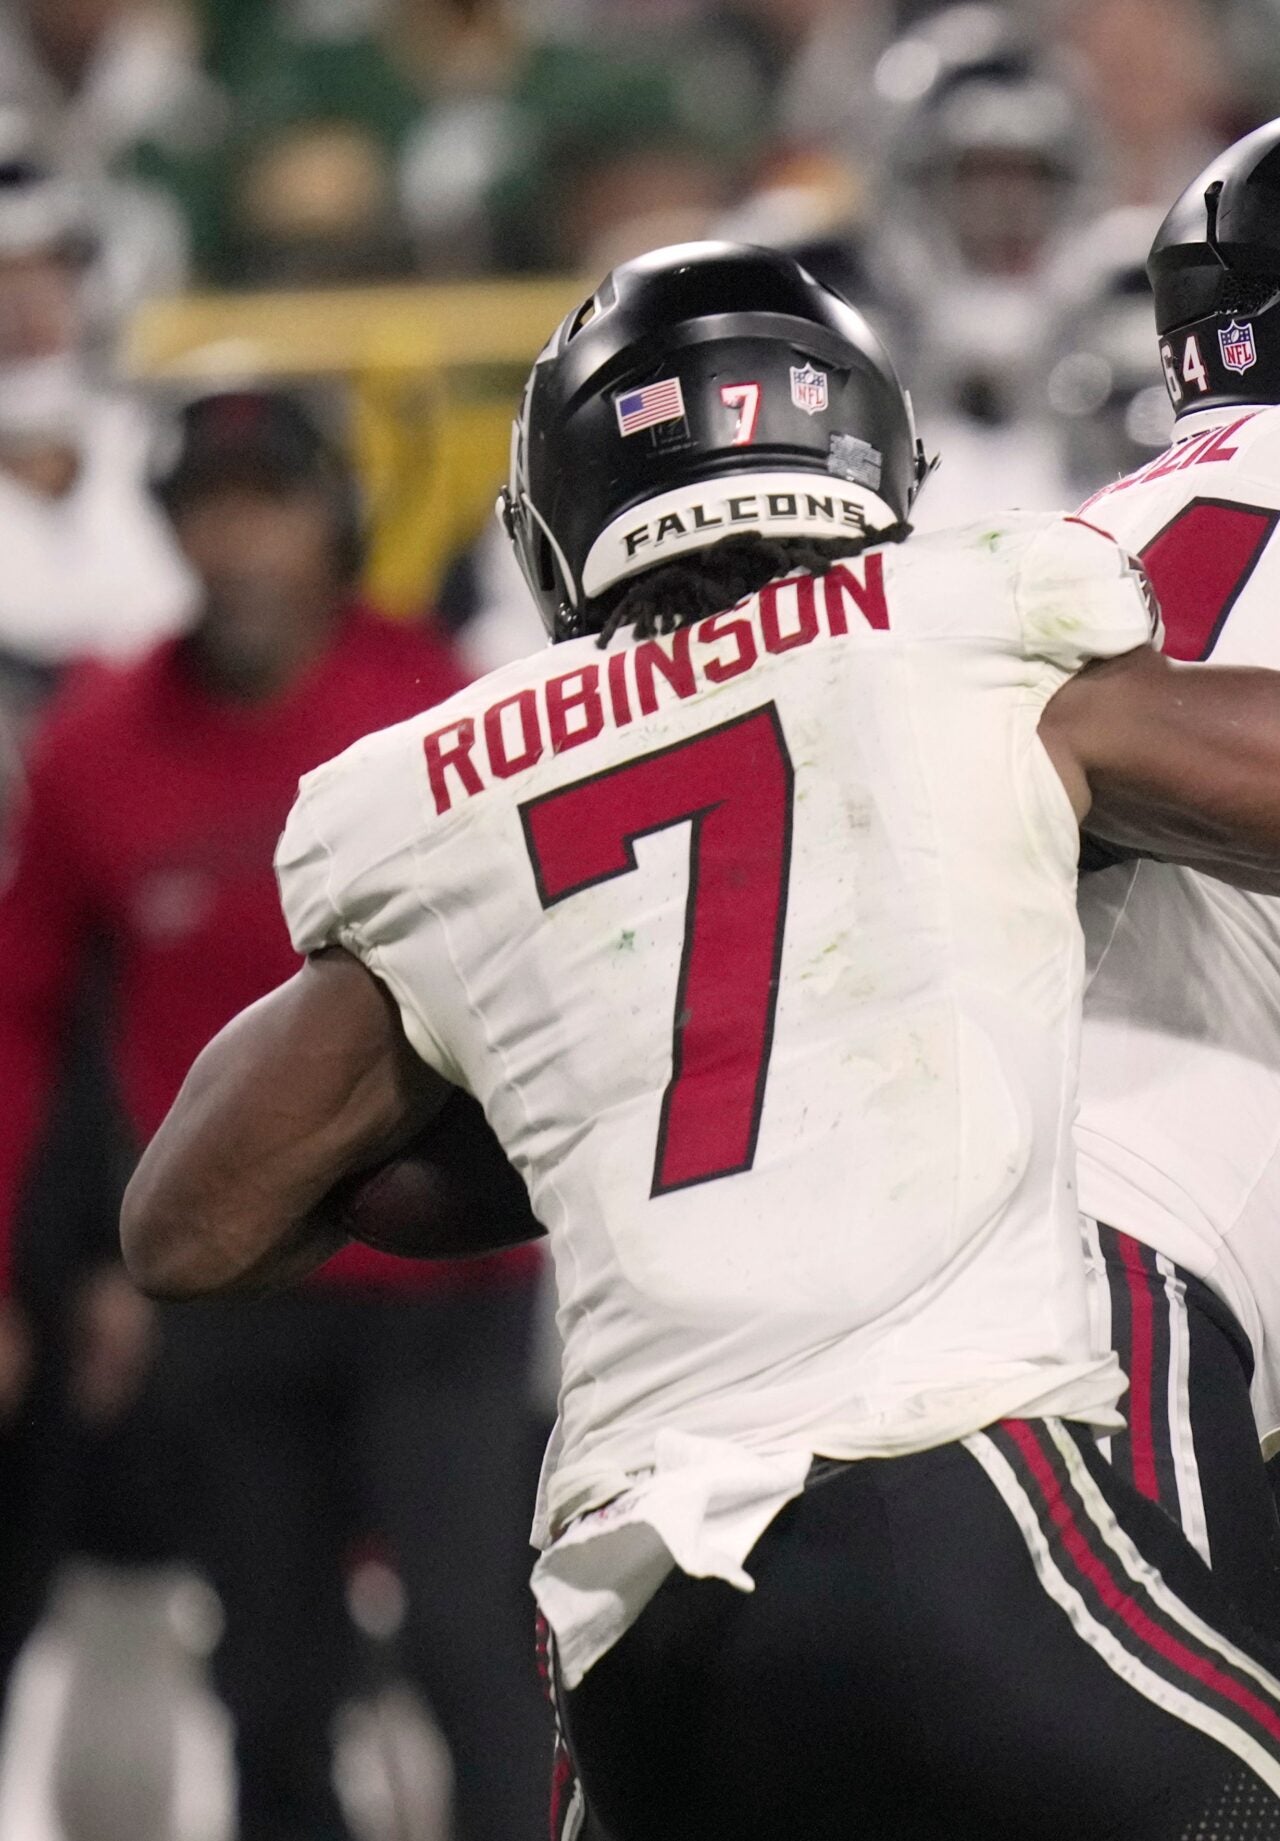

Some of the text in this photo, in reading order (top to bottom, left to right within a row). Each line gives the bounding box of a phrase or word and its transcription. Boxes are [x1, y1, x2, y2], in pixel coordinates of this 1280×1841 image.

[1161, 333, 1210, 405] 64
[1224, 344, 1252, 364] NFL
[720, 381, 761, 446] 7
[795, 384, 823, 405] NFL
[622, 493, 865, 558] FALCONS
[423, 552, 890, 816] ROBINSON
[517, 700, 795, 1199] 7
